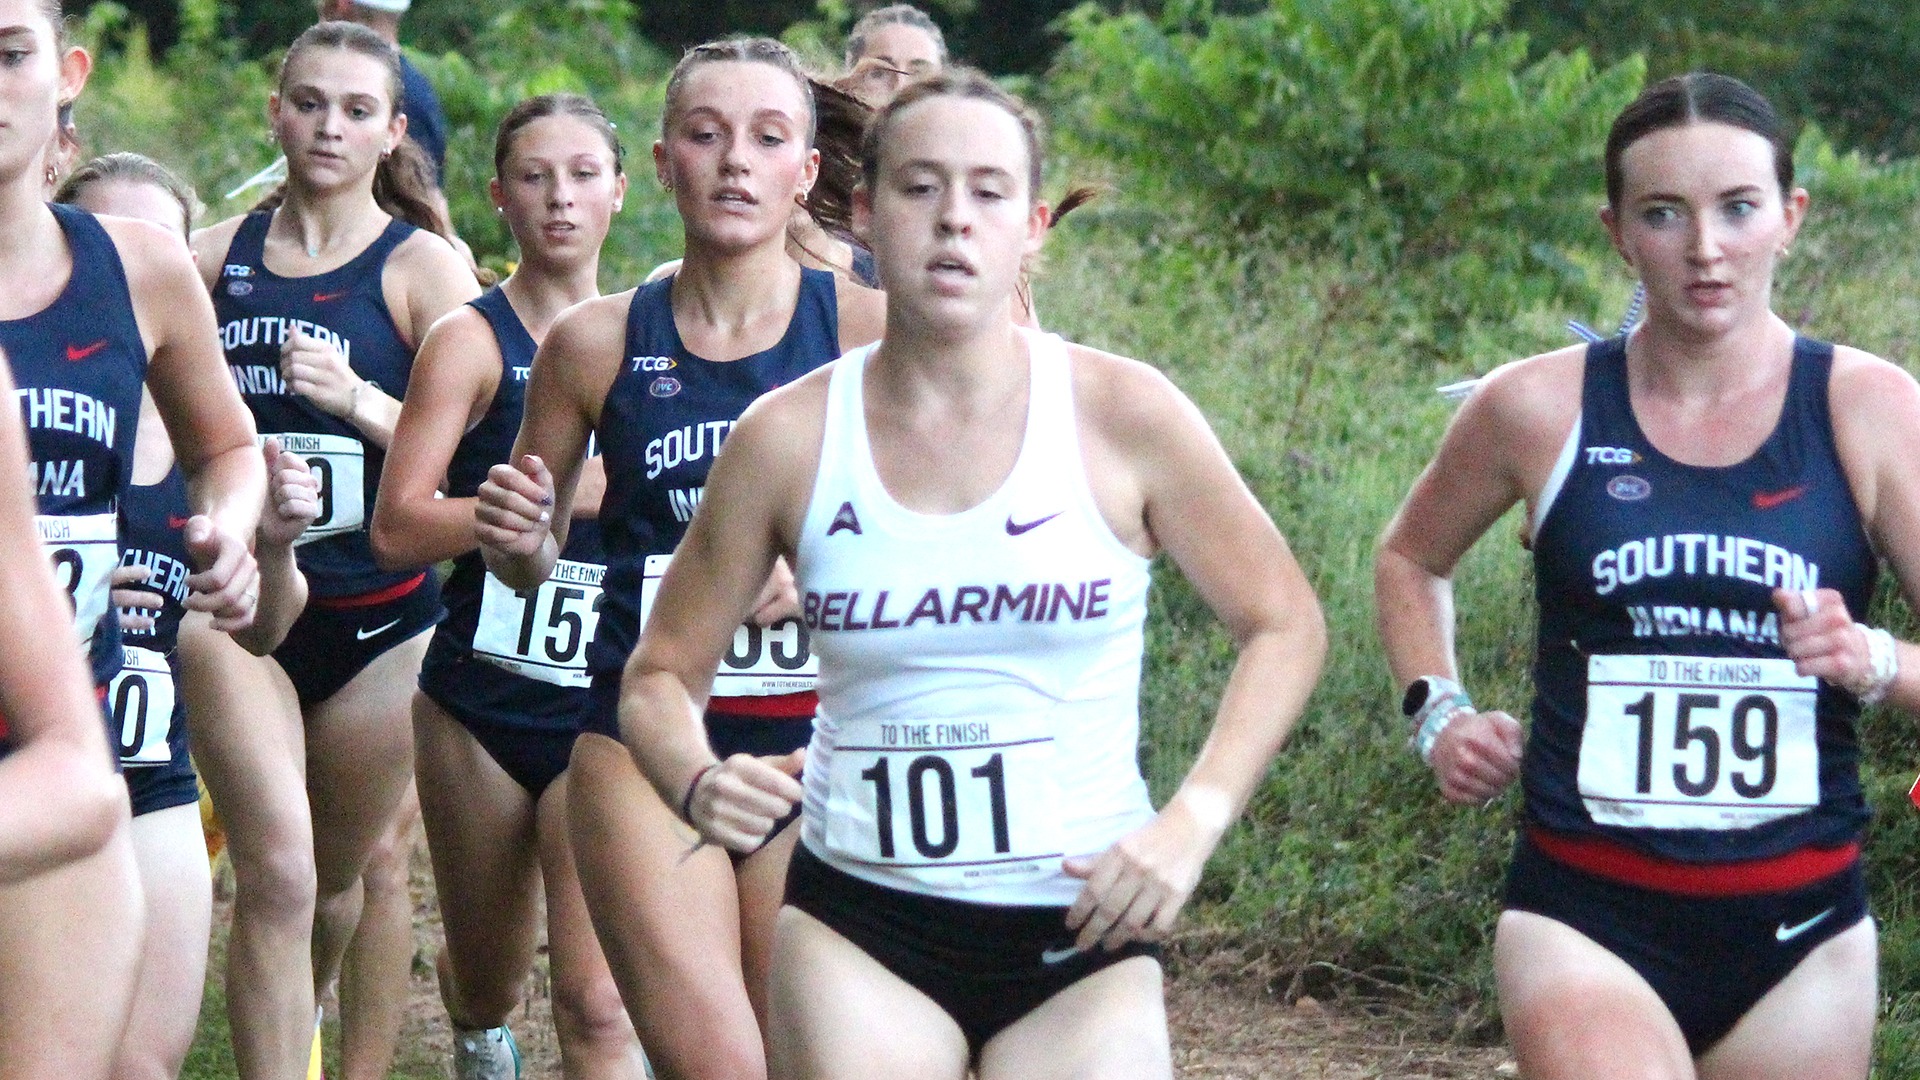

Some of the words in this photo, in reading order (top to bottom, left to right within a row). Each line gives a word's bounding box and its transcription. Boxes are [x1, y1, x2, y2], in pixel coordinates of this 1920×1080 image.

[632, 356, 669, 371] TCG
[229, 365, 287, 395] INDI
[284, 436, 320, 450] FINISH
[1585, 446, 1632, 464] TCG
[555, 563, 575, 579] THE
[1592, 534, 1819, 604] SOUTHERN
[803, 578, 1112, 632] BELLARMINE
[514, 586, 606, 668] 15
[1626, 605, 1782, 647] INDIANA
[1649, 660, 1668, 680] TO
[1674, 661, 1703, 681] THE
[1709, 663, 1761, 683] FINISH
[881, 724, 898, 745] TO
[902, 724, 932, 745] THE
[936, 722, 990, 744] FINISH
[1624, 691, 1778, 799] 159
[861, 752, 1011, 860] 101
